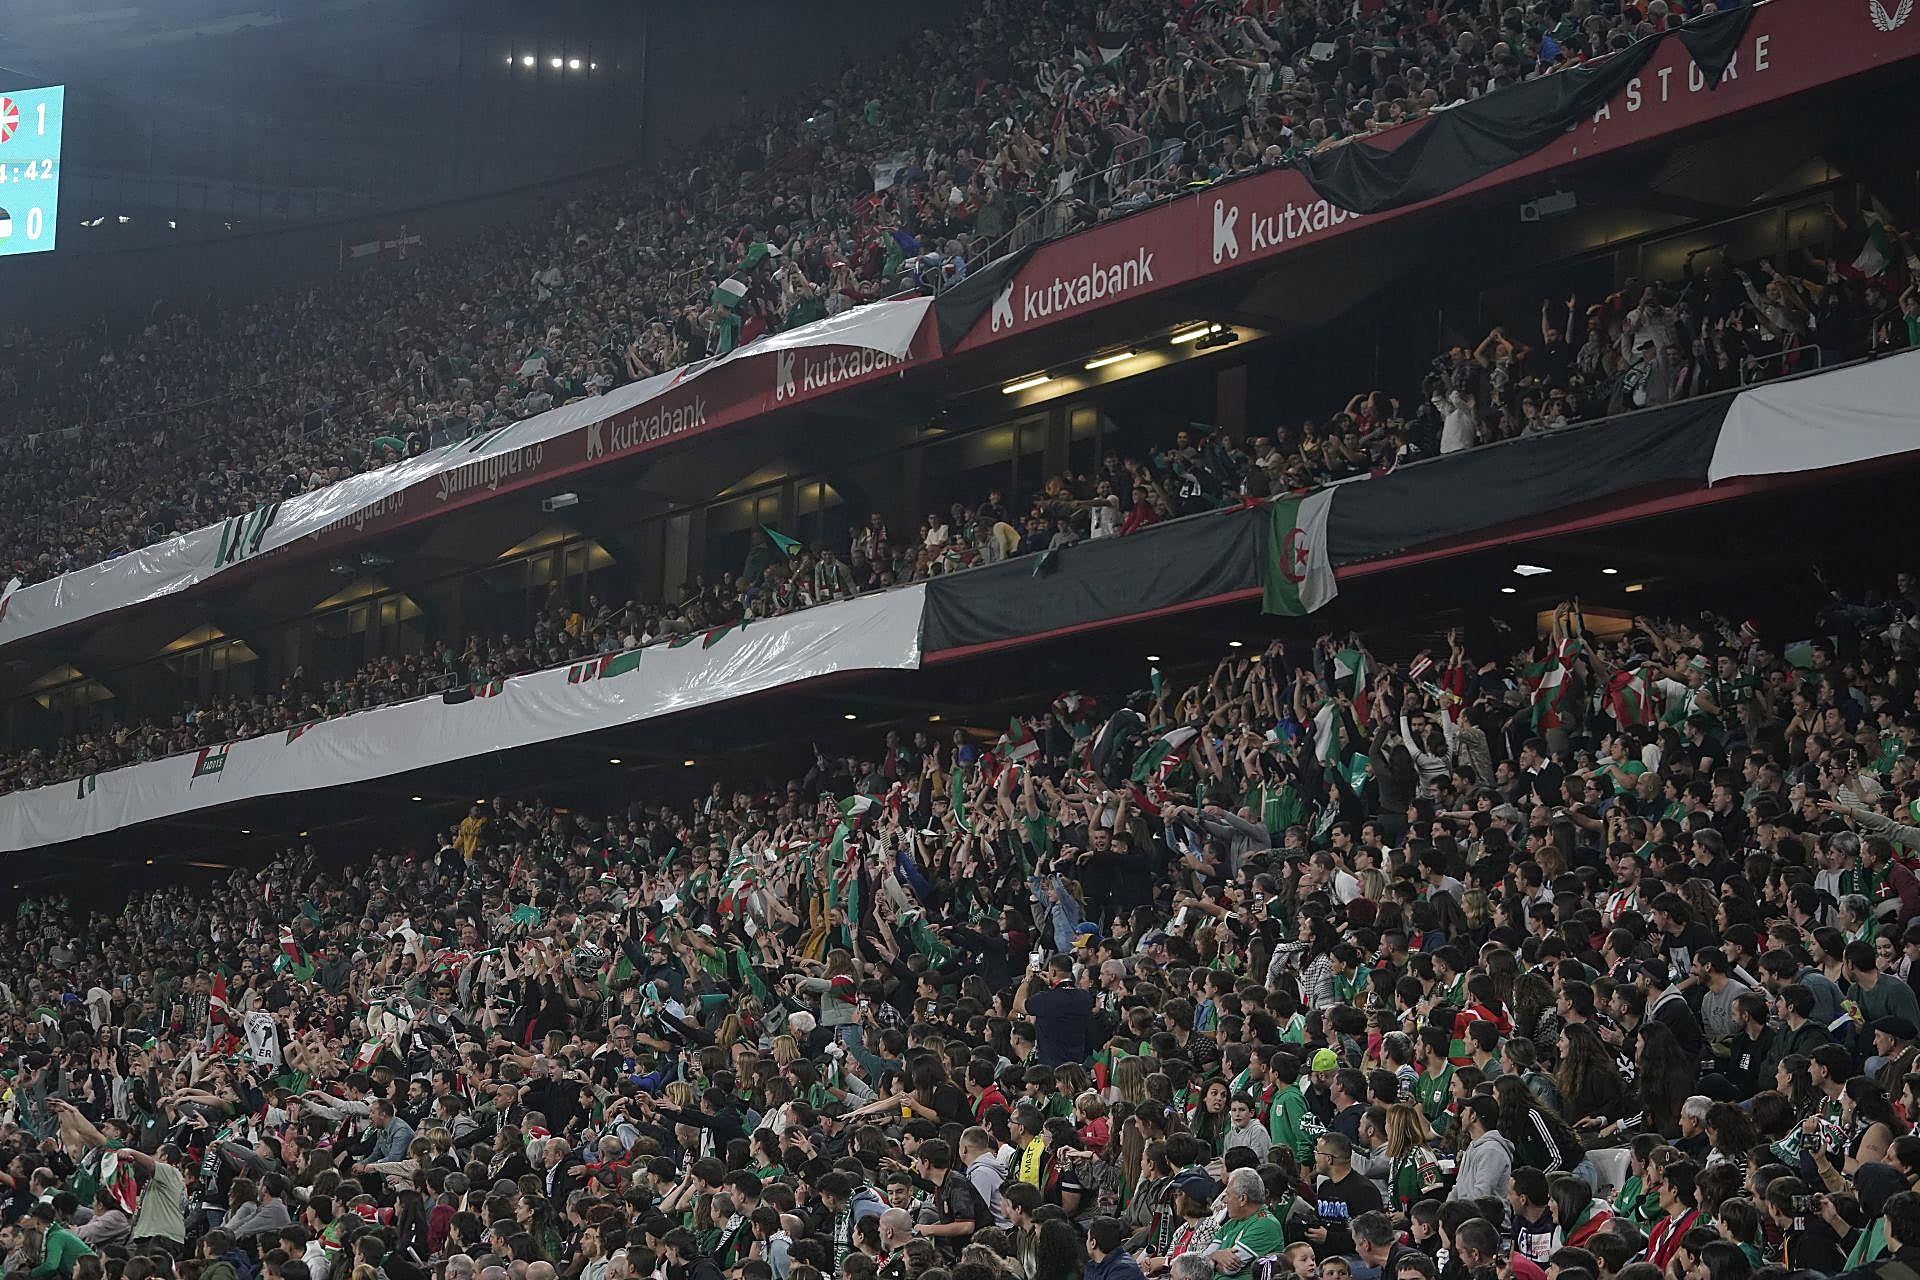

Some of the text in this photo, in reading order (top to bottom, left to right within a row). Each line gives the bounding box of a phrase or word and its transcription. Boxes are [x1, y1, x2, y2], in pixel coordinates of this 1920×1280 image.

[1567, 35, 1770, 131] ASTORE
[36, 103, 46, 136] 1
[26, 207, 43, 240] 0
[1252, 200, 1366, 251] kutxab
[1024, 247, 1154, 322] kutxabank
[611, 395, 706, 452] kutxabank
